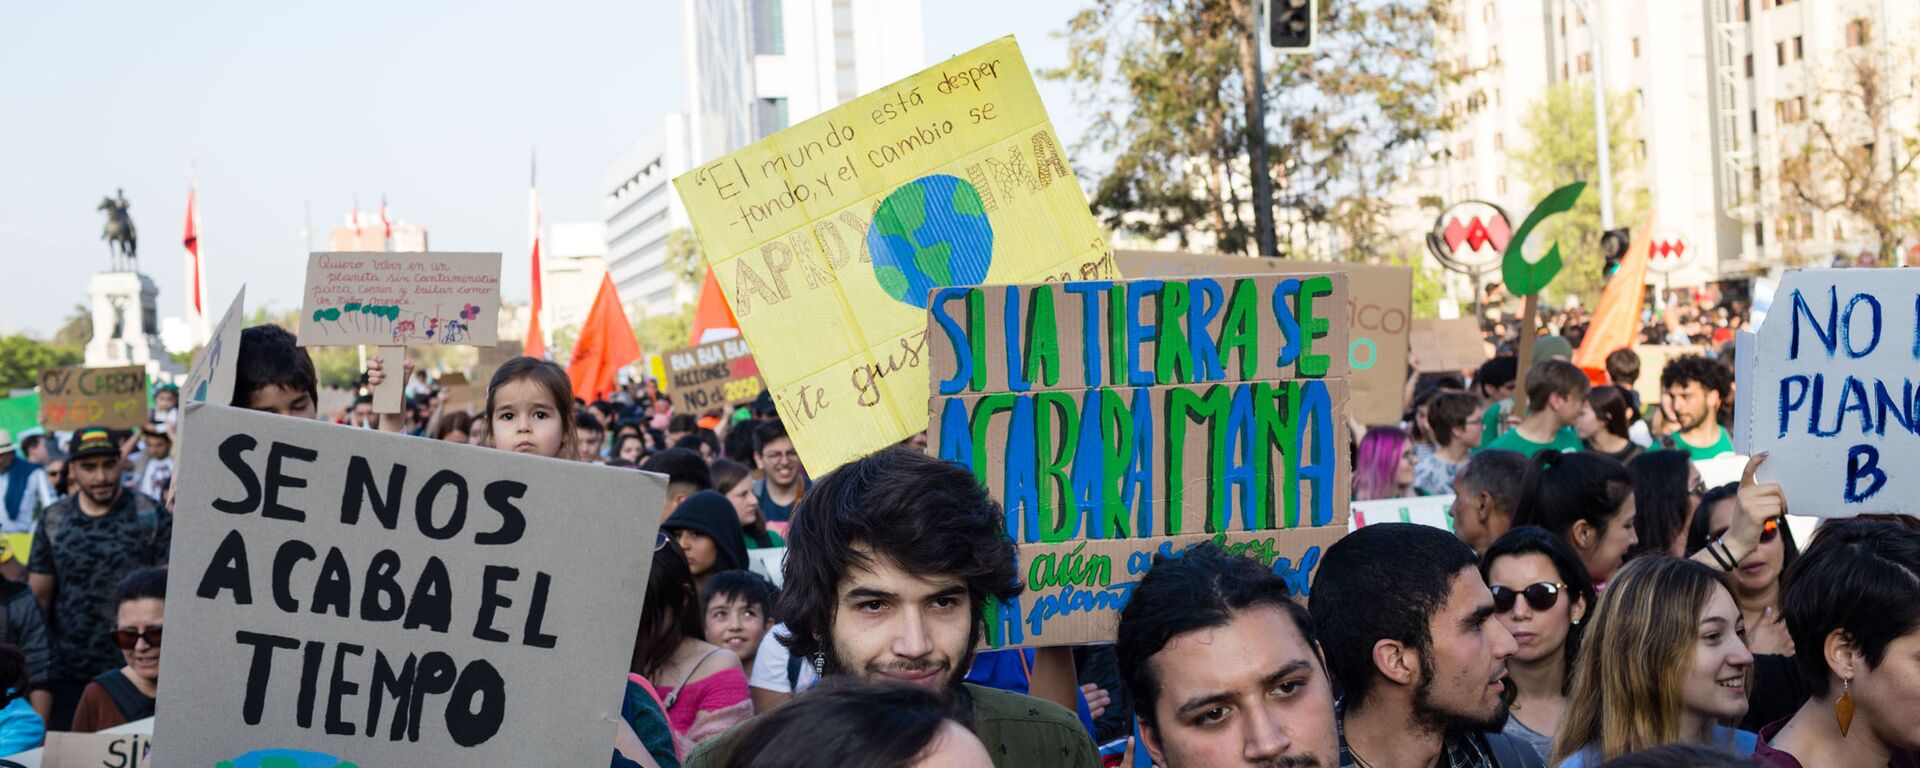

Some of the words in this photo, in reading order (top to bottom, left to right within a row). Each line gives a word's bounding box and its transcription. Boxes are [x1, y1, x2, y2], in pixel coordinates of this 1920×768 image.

[760, 122, 854, 179] mundo
[871, 85, 925, 126] está
[936, 58, 1001, 96] desper
[867, 119, 953, 169] cambio
[969, 100, 998, 126] se
[932, 287, 986, 395] SI
[1004, 284, 1060, 392] LA
[1064, 278, 1258, 388] TIERRA
[1272, 276, 1333, 378] SE
[1785, 285, 1882, 361] NO
[211, 433, 318, 523] SE
[341, 456, 528, 545] NOS
[1844, 444, 1888, 503] B
[473, 565, 557, 649] EL
[1029, 541, 1112, 592] aún
[236, 631, 505, 748] TIEMPO
